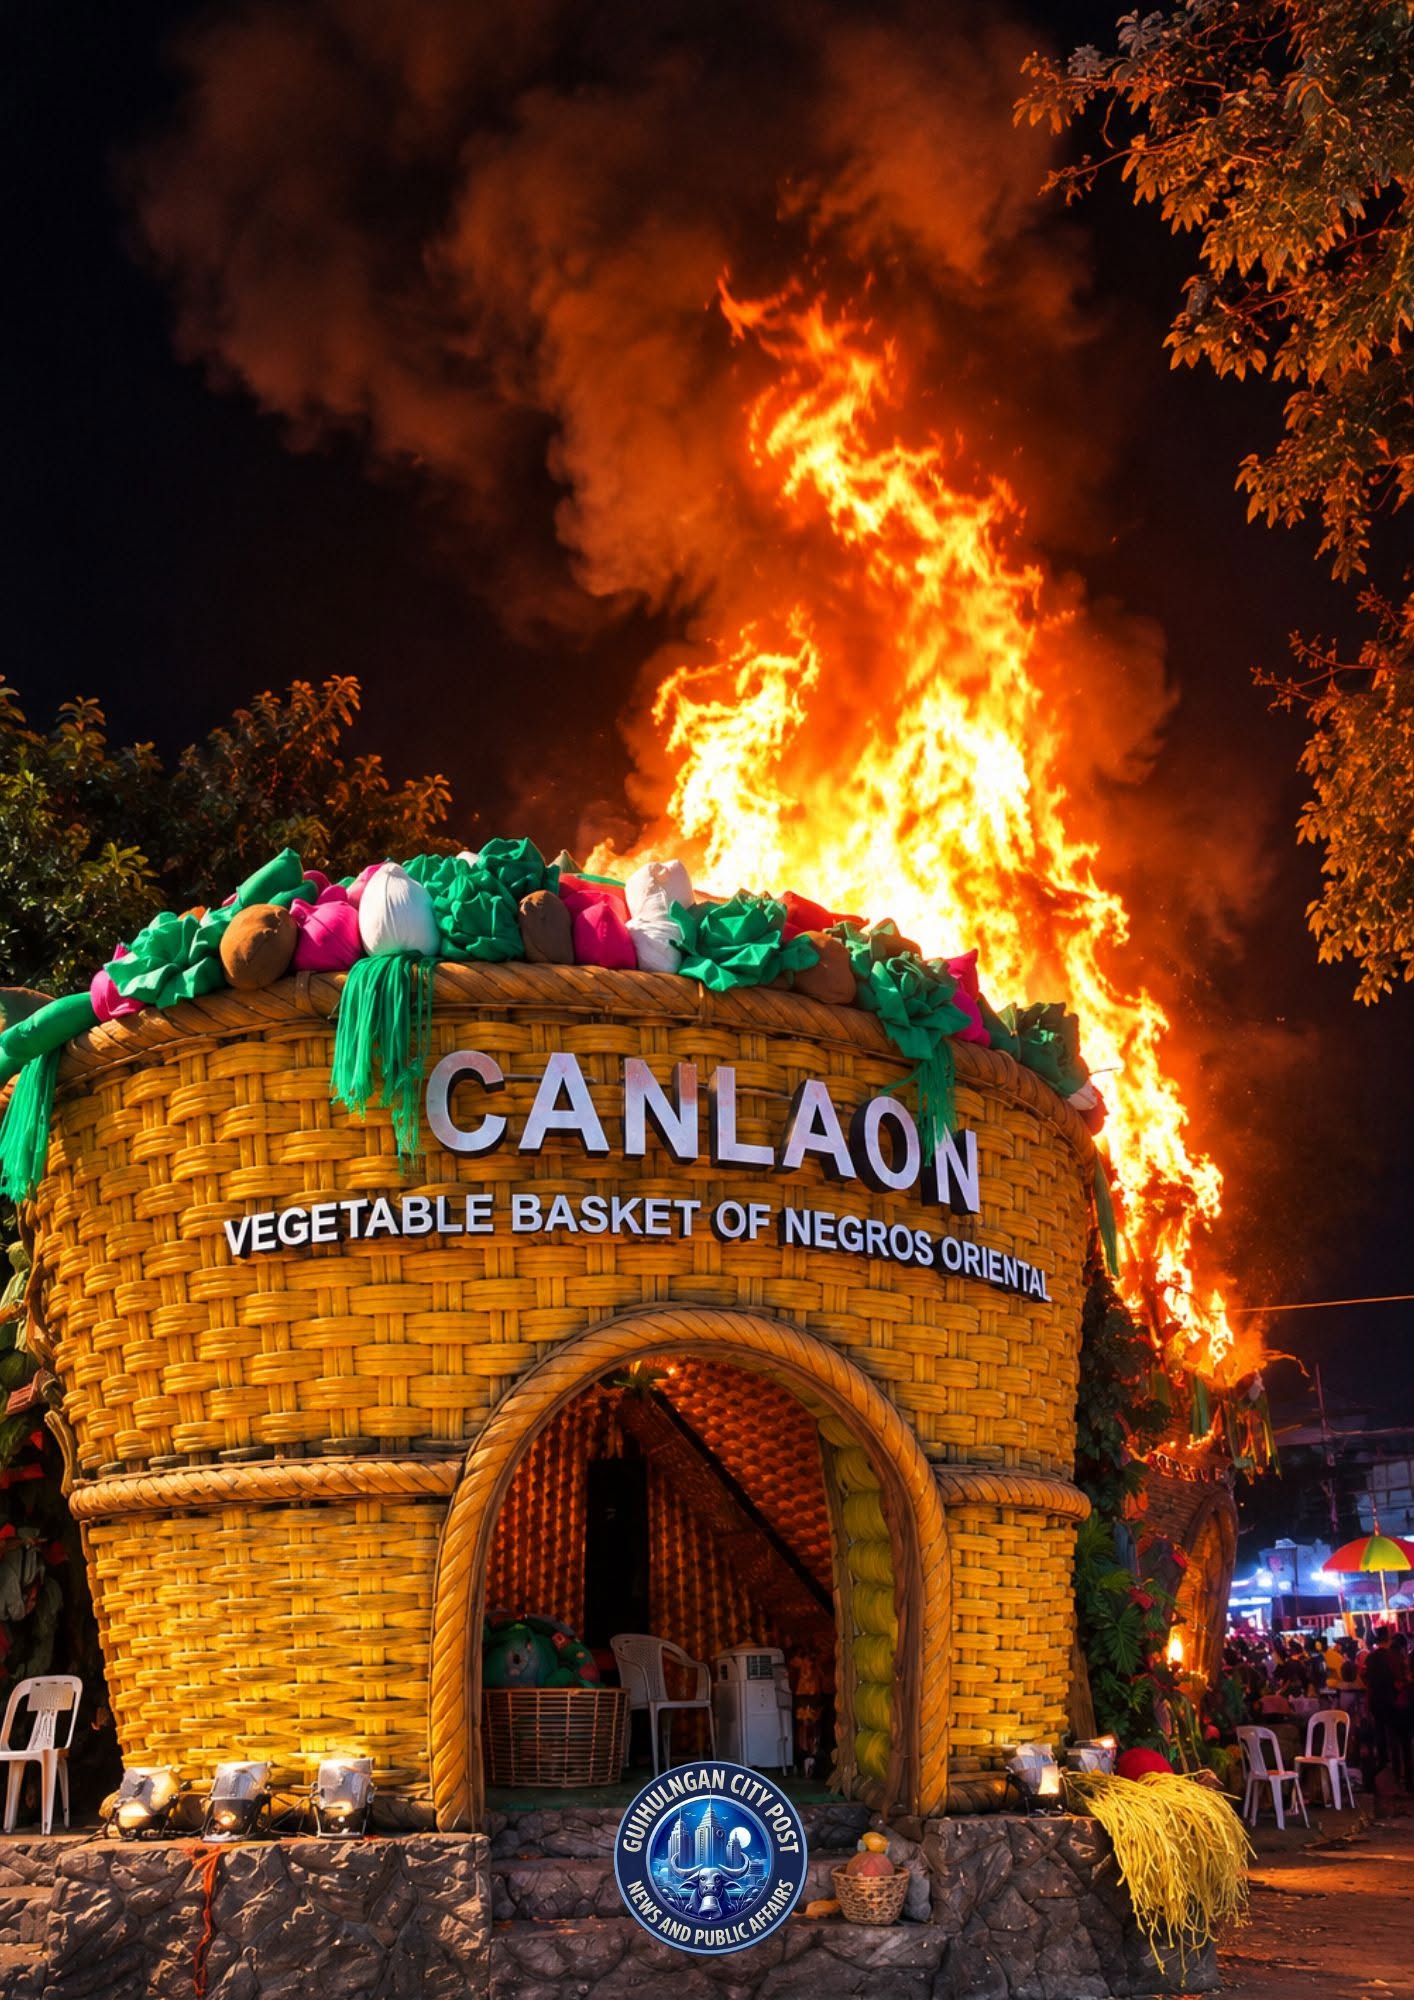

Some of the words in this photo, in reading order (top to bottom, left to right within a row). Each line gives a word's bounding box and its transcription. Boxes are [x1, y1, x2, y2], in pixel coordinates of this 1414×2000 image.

[425, 1050, 981, 1215] CANLAON
[223, 1193, 494, 1256] VEGETABLE
[511, 1194, 701, 1237] BASKET
[714, 1200, 771, 1240] OF
[783, 1206, 935, 1267] NEGROS
[940, 1235, 1052, 1303] ORIENTAL
